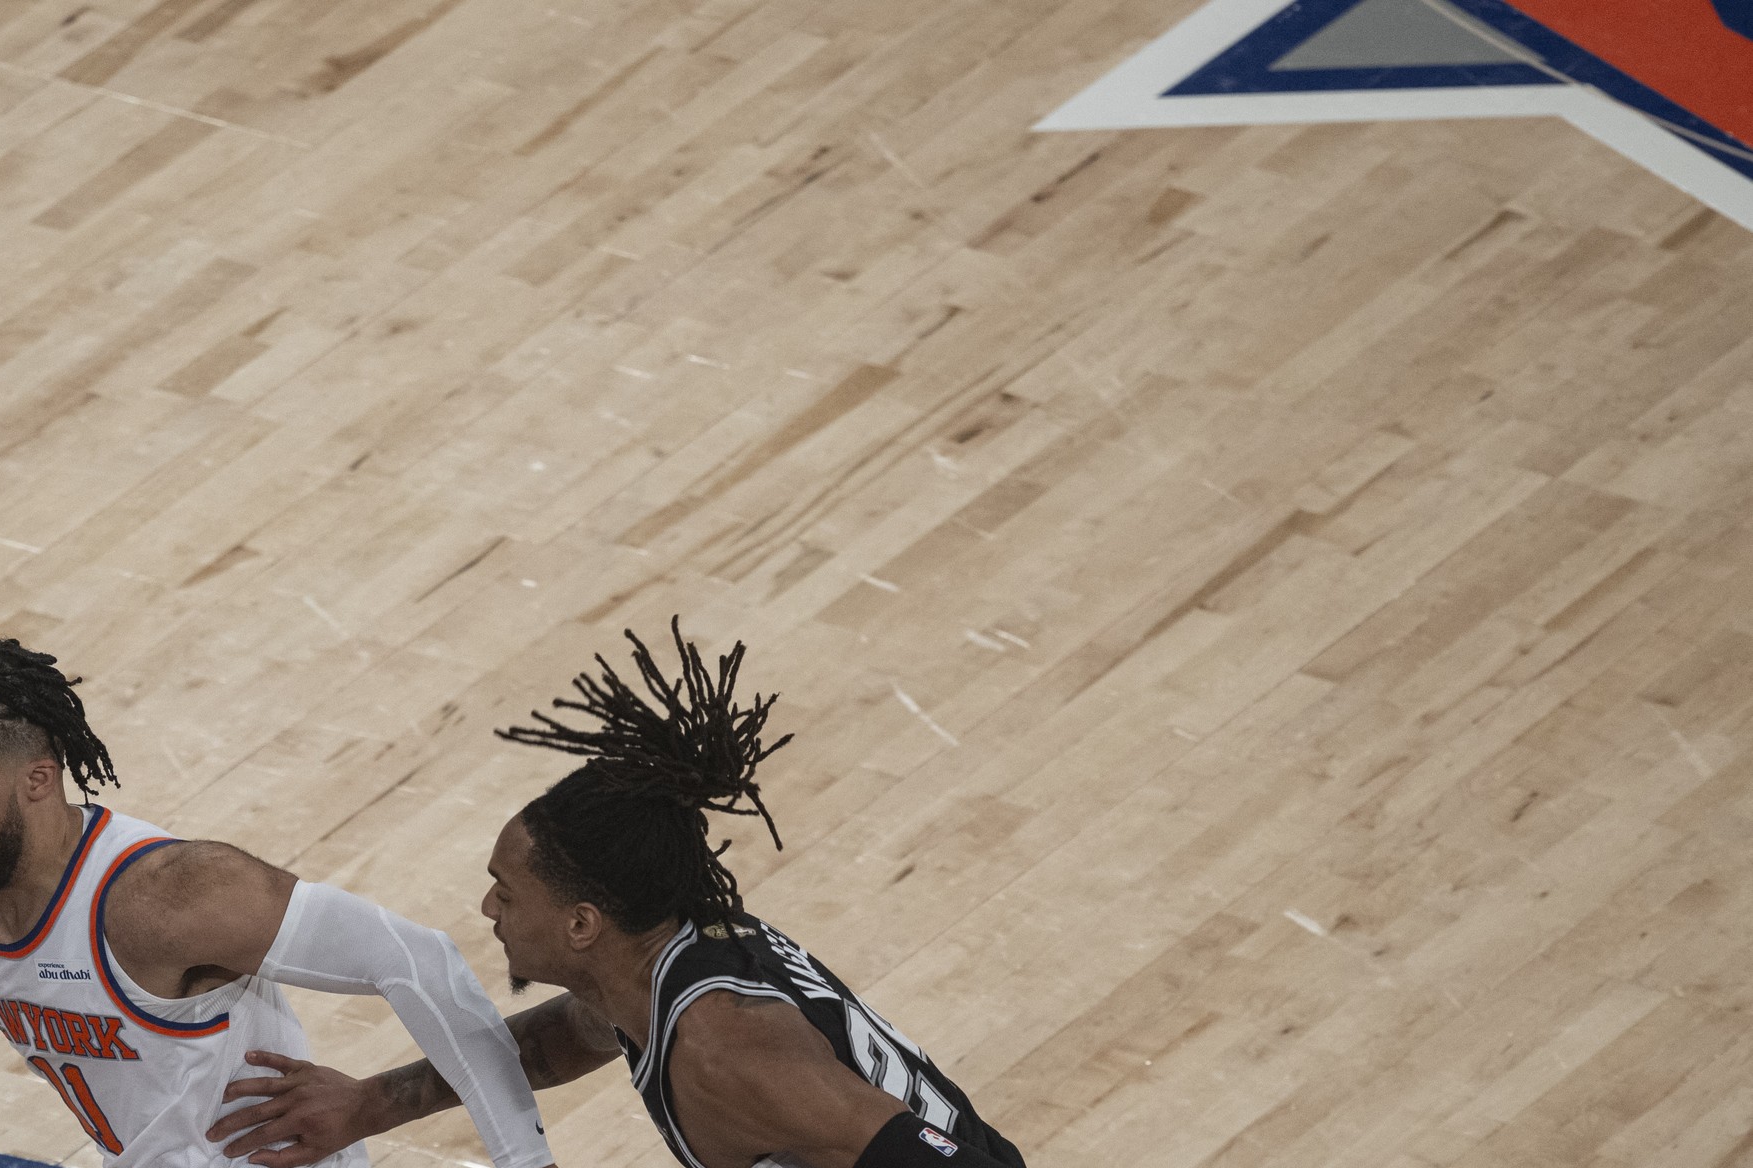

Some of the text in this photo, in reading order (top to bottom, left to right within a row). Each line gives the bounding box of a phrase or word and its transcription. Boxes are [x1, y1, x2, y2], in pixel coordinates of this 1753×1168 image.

[39, 969, 91, 980] abu dhabi
[759, 919, 842, 1001] VASSE
[19, 1001, 142, 1062] YORK
